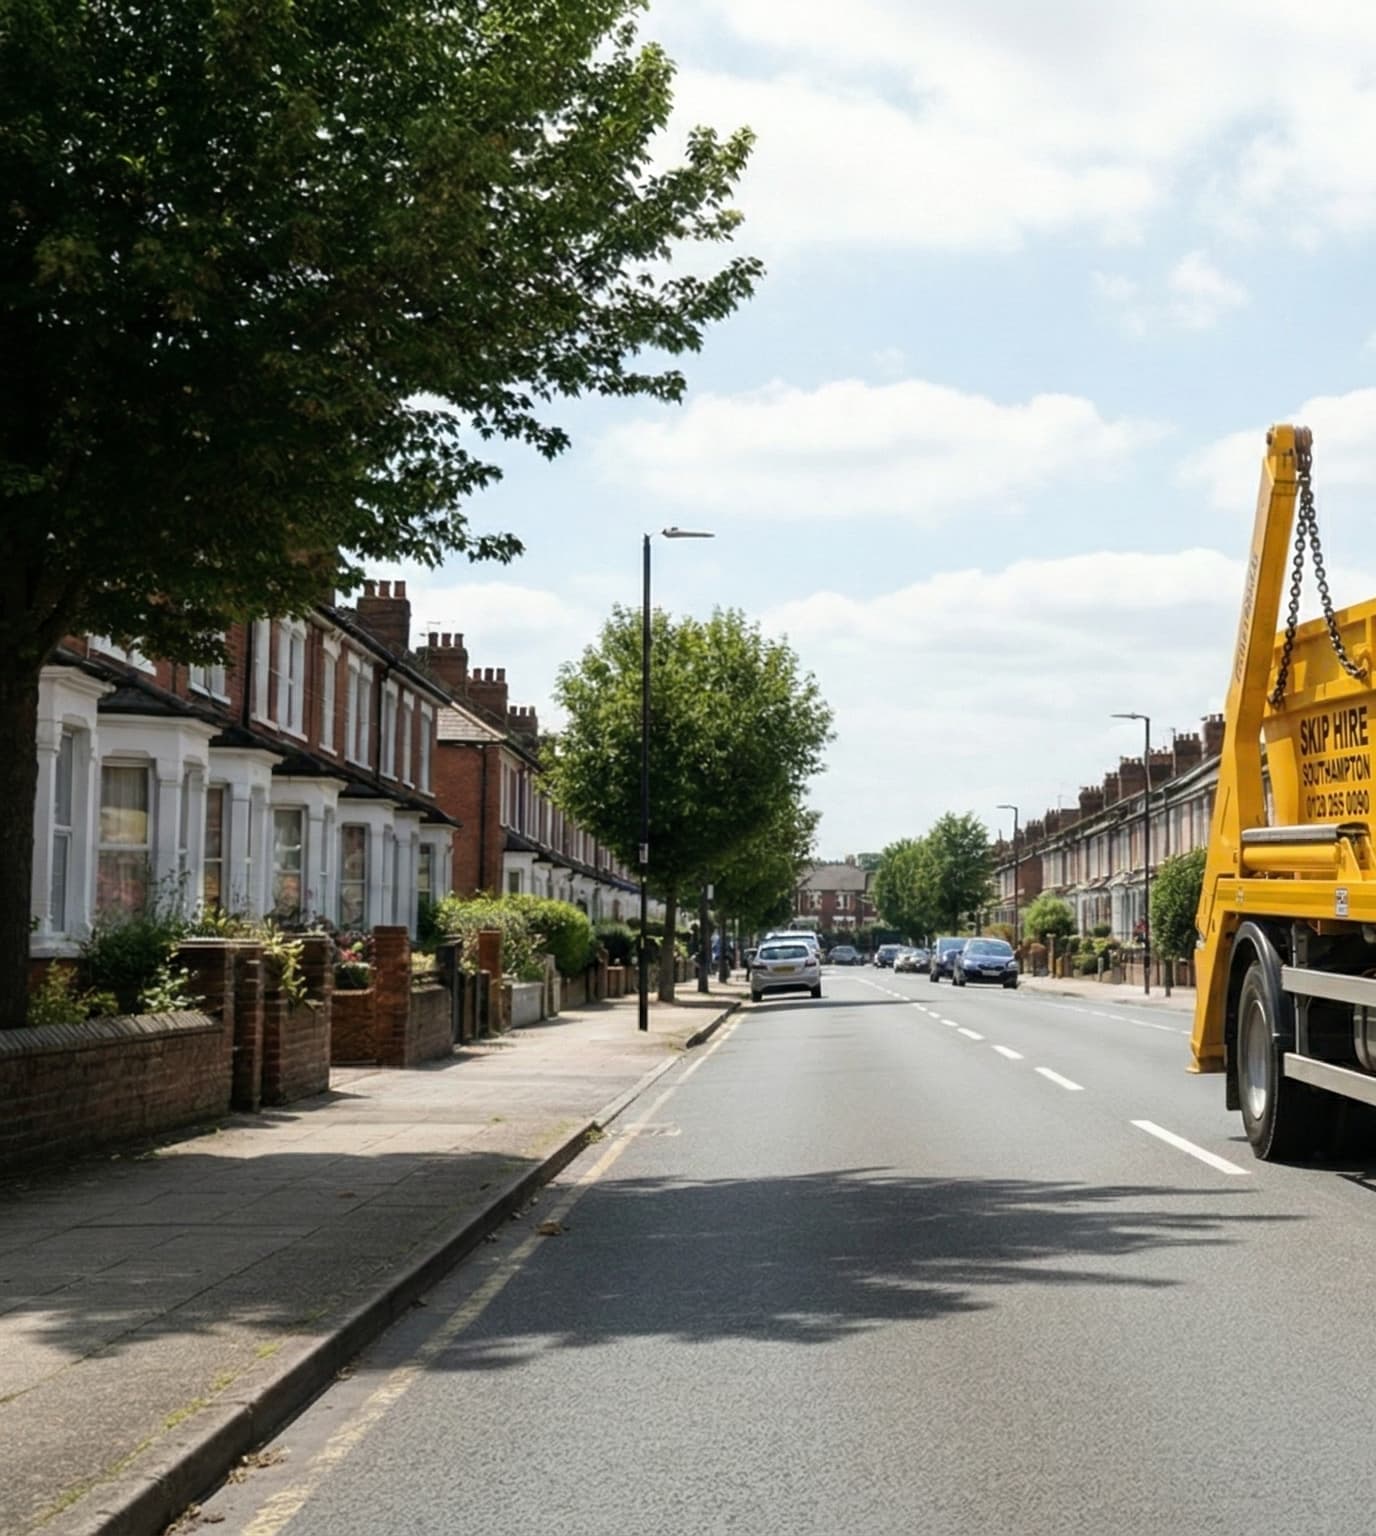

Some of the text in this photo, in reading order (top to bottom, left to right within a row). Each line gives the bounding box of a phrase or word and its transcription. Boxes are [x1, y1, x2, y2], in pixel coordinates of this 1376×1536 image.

[1301, 706, 1368, 755] SKIP HIRE
[1303, 753, 1371, 786] SOUTHAMPTON
